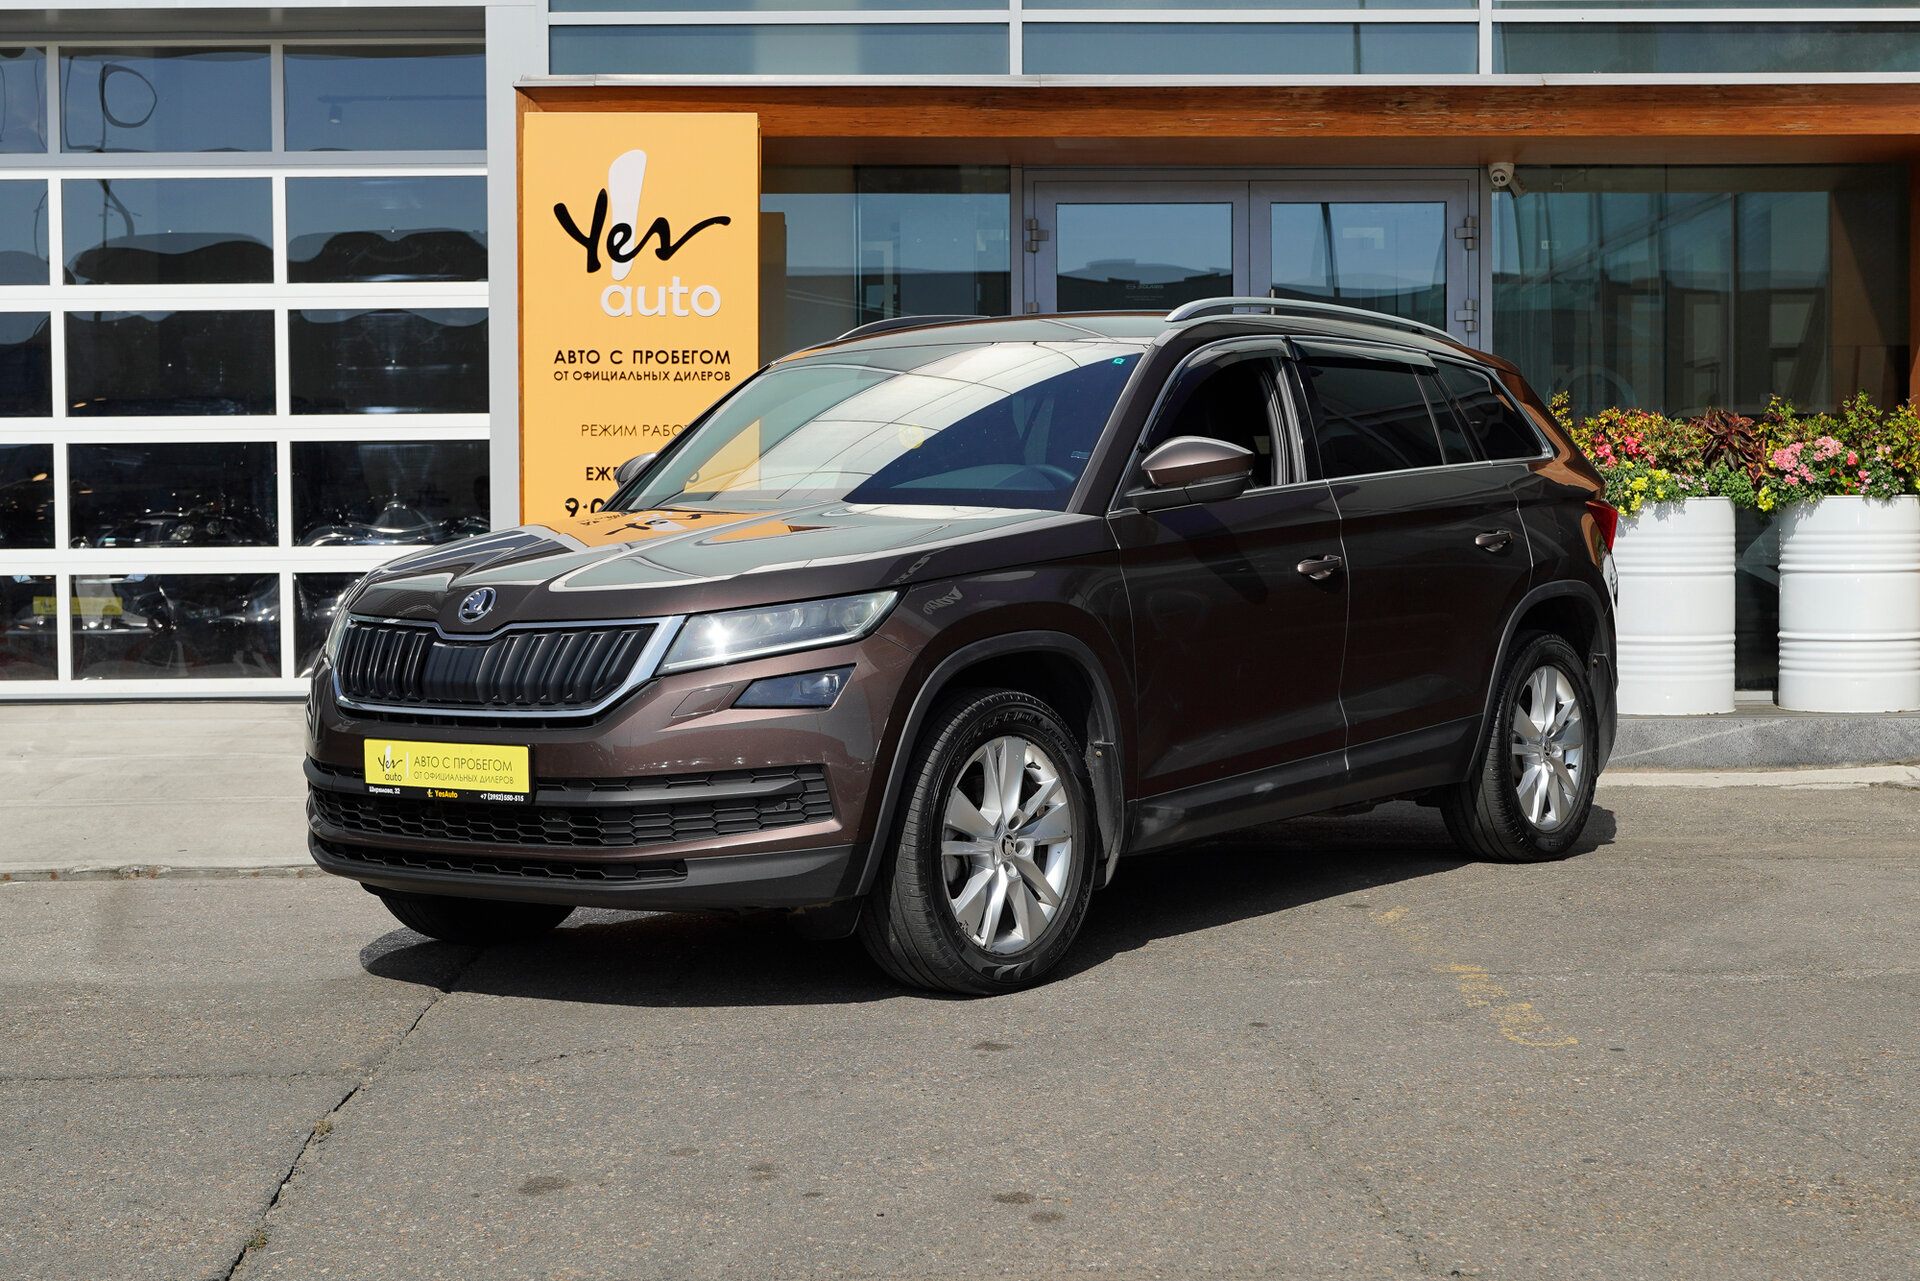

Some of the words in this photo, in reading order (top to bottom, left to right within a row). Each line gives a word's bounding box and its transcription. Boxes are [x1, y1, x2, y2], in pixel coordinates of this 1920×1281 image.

[554, 188, 731, 273] Yes
[601, 277, 721, 317] auto
[554, 350, 600, 364] АВТО
[610, 350, 623, 364] С
[633, 350, 730, 364] ПРОБЕГОМ
[554, 371, 569, 381] ОТ
[573, 371, 670, 382] ОФИЦИАЛЬНЫХ
[674, 371, 730, 382] ДИЛЕРОВ
[582, 424, 637, 437] РЕЖИМ
[643, 424, 688, 437] РАБО
[414, 756, 439, 768] АВТО
[442, 757, 450, 769] С
[453, 757, 513, 771] ПРОБЕГОМ
[385, 773, 402, 781] auto
[414, 771, 423, 779] ОТ
[424, 771, 478, 783] ОФИЦИАЛЬНЫХ
[480, 775, 514, 784] ДИЛЕРОВ
